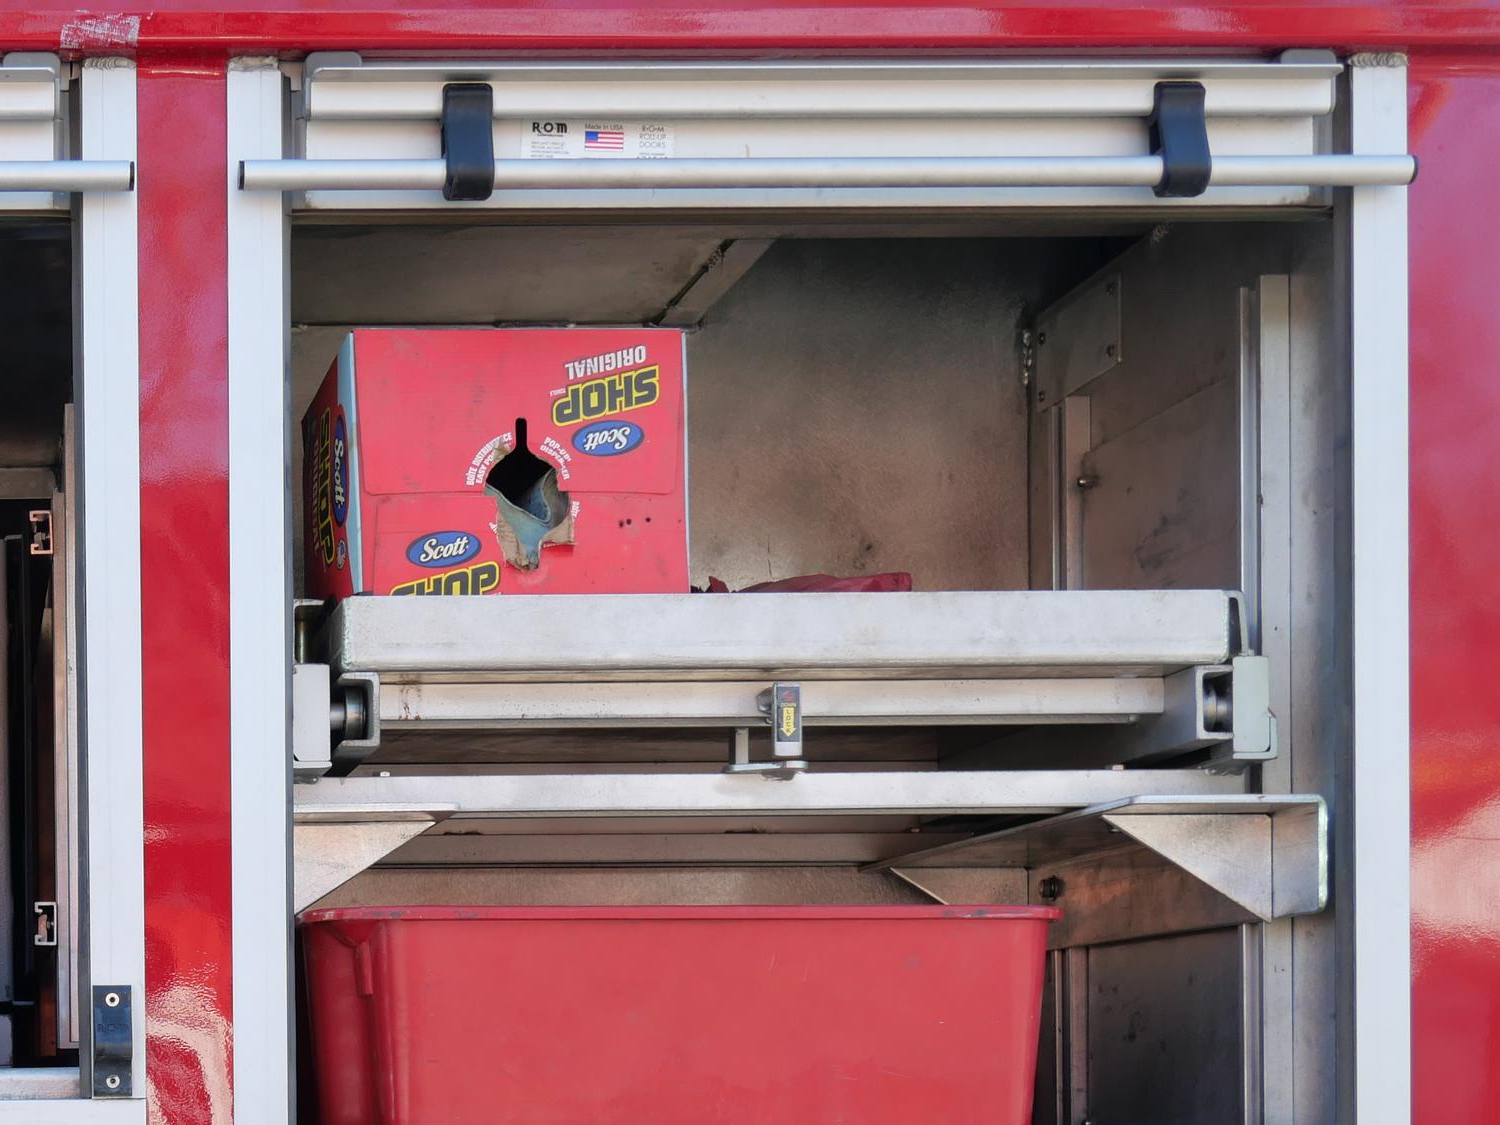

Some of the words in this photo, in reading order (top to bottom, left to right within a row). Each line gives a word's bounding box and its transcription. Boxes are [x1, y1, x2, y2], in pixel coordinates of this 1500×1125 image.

[609, 123, 624, 131] USA
[564, 344, 647, 380] ORIGINAL
[551, 364, 660, 427] SHOP
[583, 426, 631, 451] Scott
[334, 438, 346, 509] Scott
[419, 536, 469, 562] Scott
